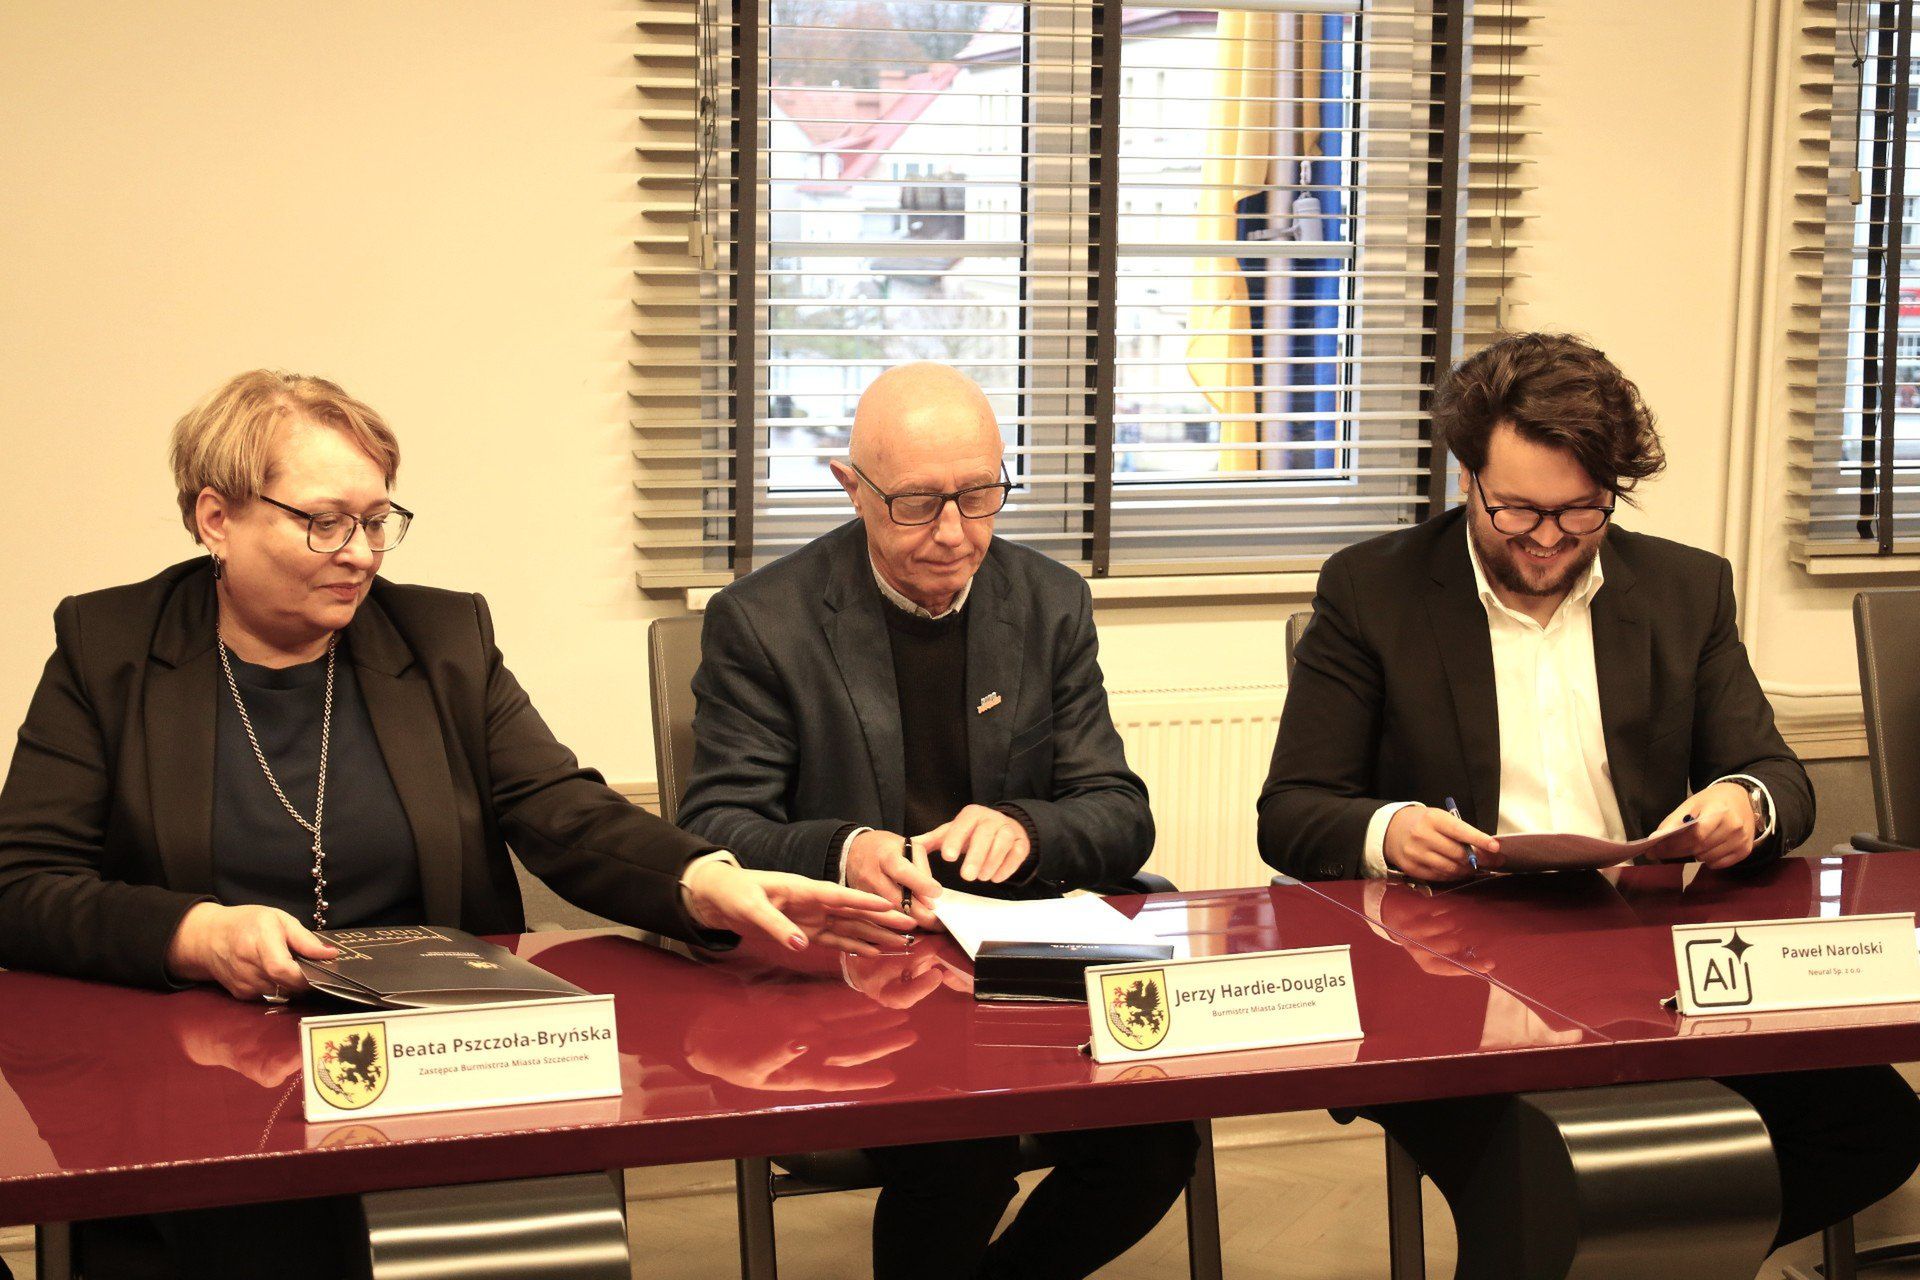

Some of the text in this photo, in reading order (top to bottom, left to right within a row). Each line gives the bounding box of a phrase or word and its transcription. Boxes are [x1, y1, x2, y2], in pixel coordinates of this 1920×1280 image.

[1781, 941, 1883, 959] Paweł Narolski
[1703, 957, 1737, 992] AI
[1808, 968, 1832, 976] Neural
[1175, 973, 1347, 1007] Jerzy Hardie-Douglas
[1212, 999, 1317, 1017] Burmistrz Miasta Szczecinek
[393, 1025, 612, 1059] Beata Pszczoła-Bryńska
[419, 1052, 590, 1076] Zastępca Burmistrza Miasta Szczecinek
